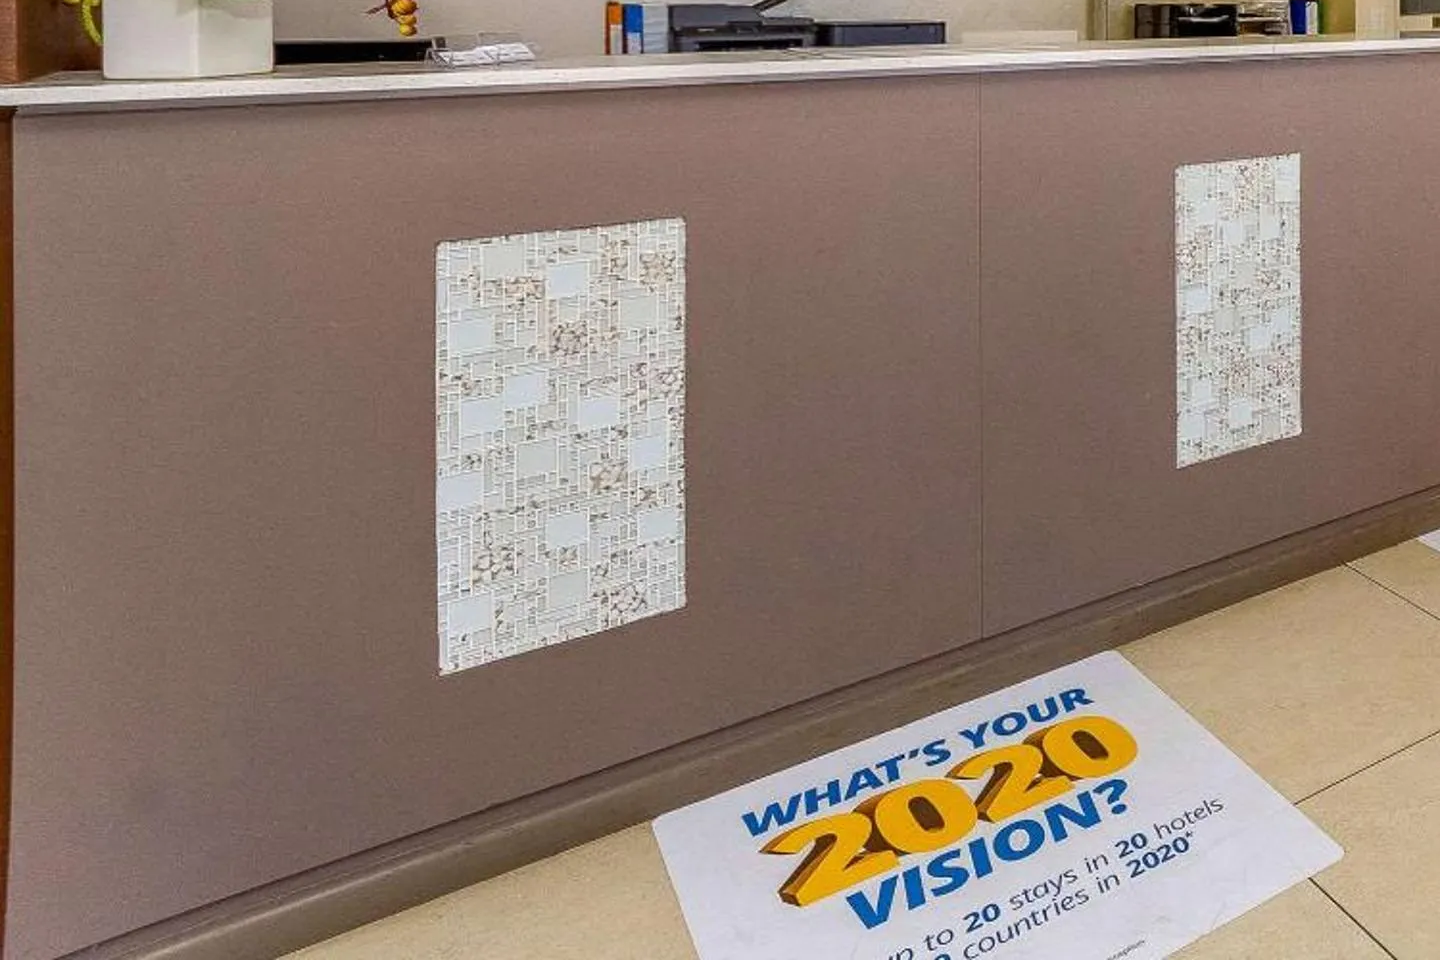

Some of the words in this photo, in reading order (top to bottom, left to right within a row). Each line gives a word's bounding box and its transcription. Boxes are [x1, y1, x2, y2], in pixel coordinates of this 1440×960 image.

[741, 739, 951, 837] WHAT'S
[958, 688, 1095, 750] YOUR
[758, 715, 1139, 907] 2020
[846, 779, 1129, 930] VISION?
[923, 929, 954, 951] to
[962, 903, 1001, 932] 20
[1009, 868, 1078, 911] stays
[1084, 854, 1109, 873] in
[1115, 833, 1147, 858] 20
[1154, 798, 1224, 839] hotels
[963, 889, 1090, 960] countries
[1096, 874, 1120, 894] in
